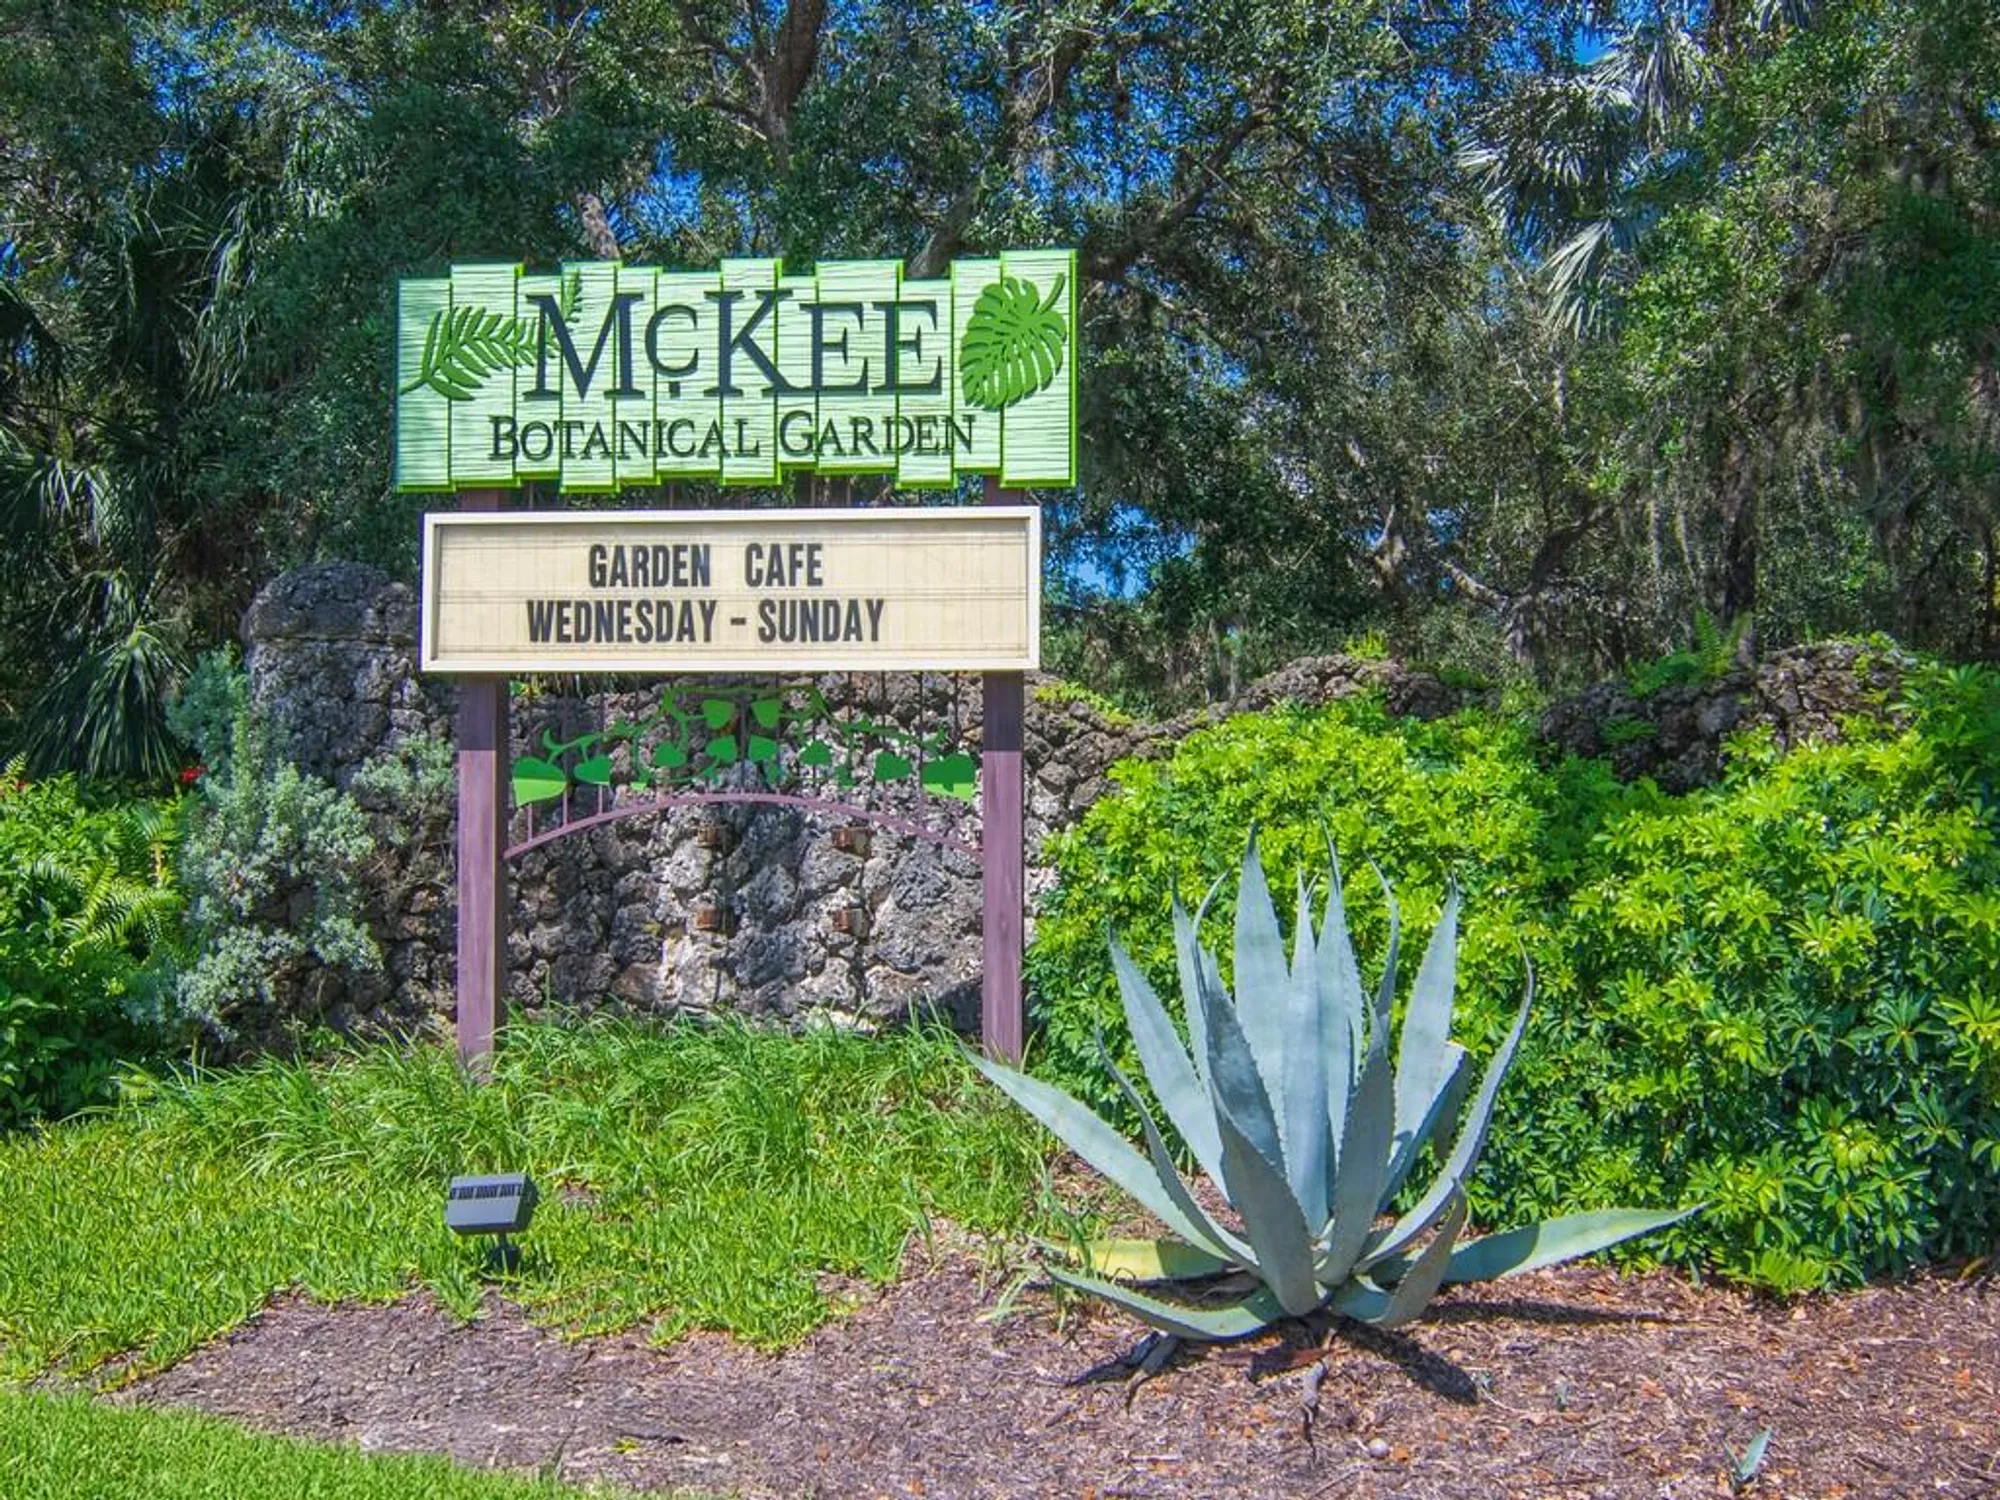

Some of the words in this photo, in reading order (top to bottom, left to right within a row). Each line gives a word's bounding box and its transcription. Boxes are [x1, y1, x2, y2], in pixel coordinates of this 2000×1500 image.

[488, 414, 760, 462] BOTANICAL
[779, 410, 976, 457] GARDEN
[588, 543, 711, 588] GARDEN
[744, 542, 824, 588] CAFE
[527, 599, 716, 644] WEDNESDAY
[758, 598, 885, 643] SUNDAY
